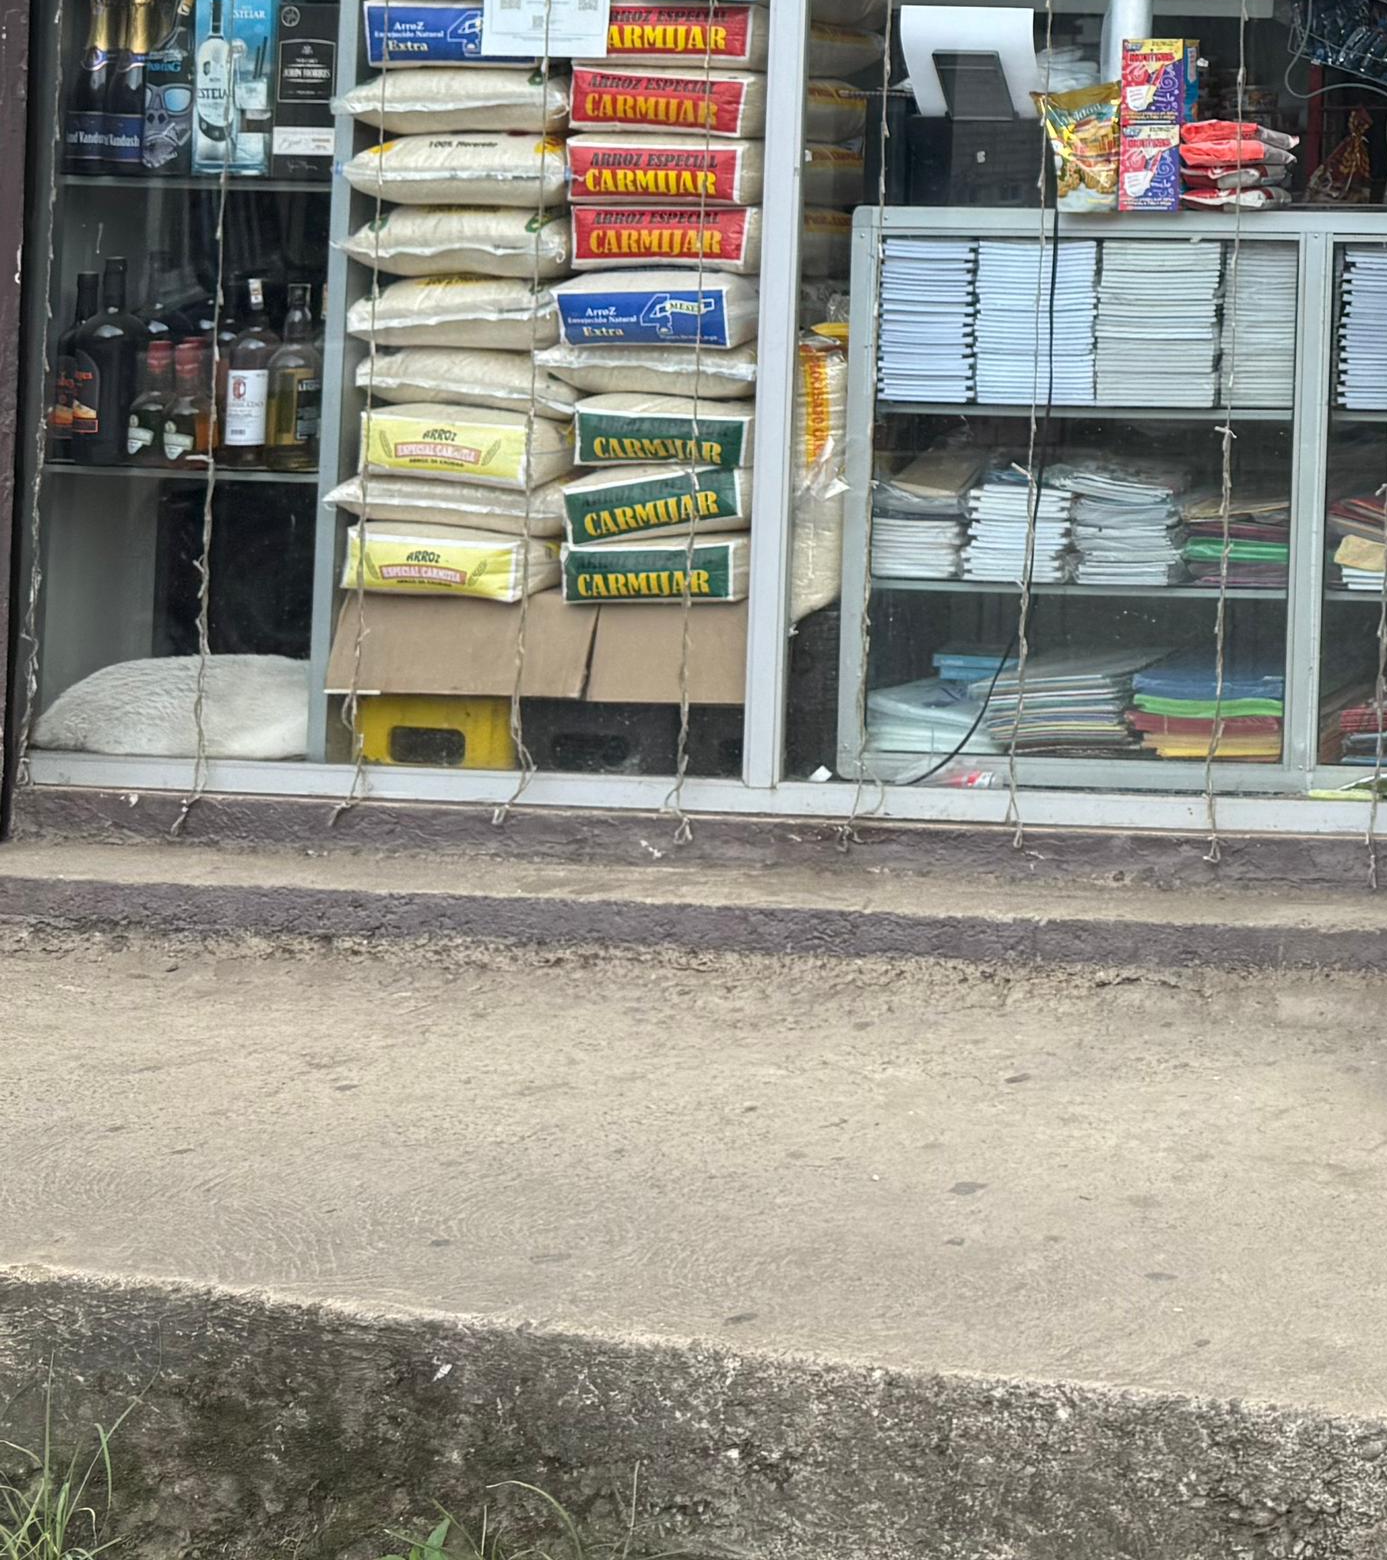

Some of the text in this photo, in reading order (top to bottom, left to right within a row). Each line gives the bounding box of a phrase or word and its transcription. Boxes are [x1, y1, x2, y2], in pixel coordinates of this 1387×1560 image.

[658, 9, 729, 24] ESPECIAL
[388, 40, 429, 51] Extra
[608, 25, 728, 51] ARMIJAR
[588, 74, 716, 95] ARROZ ESPECIAL
[585, 93, 718, 127] CARMIJAR
[591, 152, 718, 169] ARROZ ESPECIAL
[585, 169, 717, 195] CARMIJAR
[593, 211, 720, 225] ARROZ ESPECIAL
[590, 229, 722, 255] CARMIJAR
[609, 315, 636, 324] Natural
[582, 326, 624, 337] Extra
[422, 429, 458, 442] ARROZ
[593, 436, 723, 465] CARMIJAR
[584, 490, 720, 537] CARMIJAR
[406, 551, 441, 564] ARROZ
[577, 570, 711, 597] CARMIJAR
